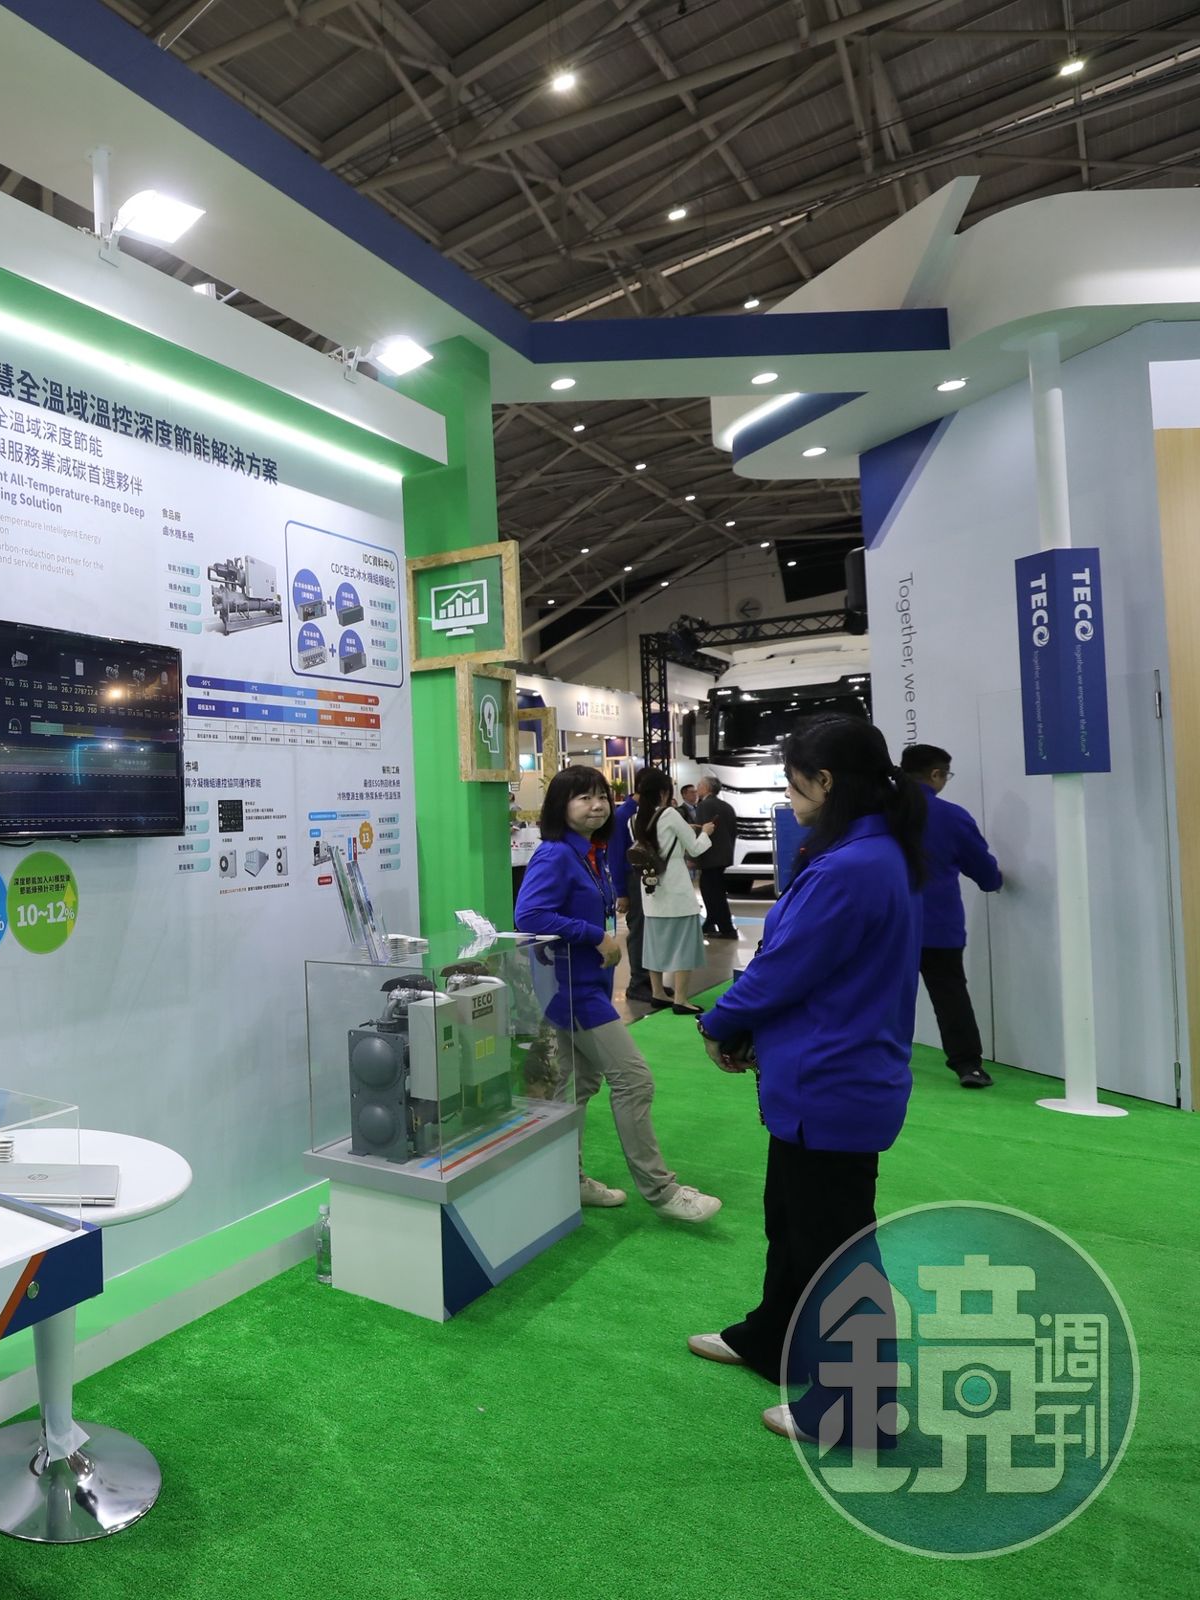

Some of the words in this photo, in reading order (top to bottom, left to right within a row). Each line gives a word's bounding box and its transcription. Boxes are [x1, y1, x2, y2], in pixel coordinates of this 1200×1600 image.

[10, 473, 121, 514] All-Temperature-Range
[124, 502, 145, 520] Deep
[20, 493, 62, 514] Solution
[44, 522, 78, 538] Intelligent
[80, 529, 102, 545] Energy
[14, 558, 39, 570] service
[40, 562, 74, 577] industries
[57, 552, 82, 568] partner
[82, 558, 92, 569] for
[93, 560, 104, 571] the
[1030, 572, 1050, 648] TECO
[1072, 568, 1094, 642] TECO
[896, 572, 917, 668] Together,
[904, 673, 916, 703] we
[472, 992, 492, 1008] TECO
